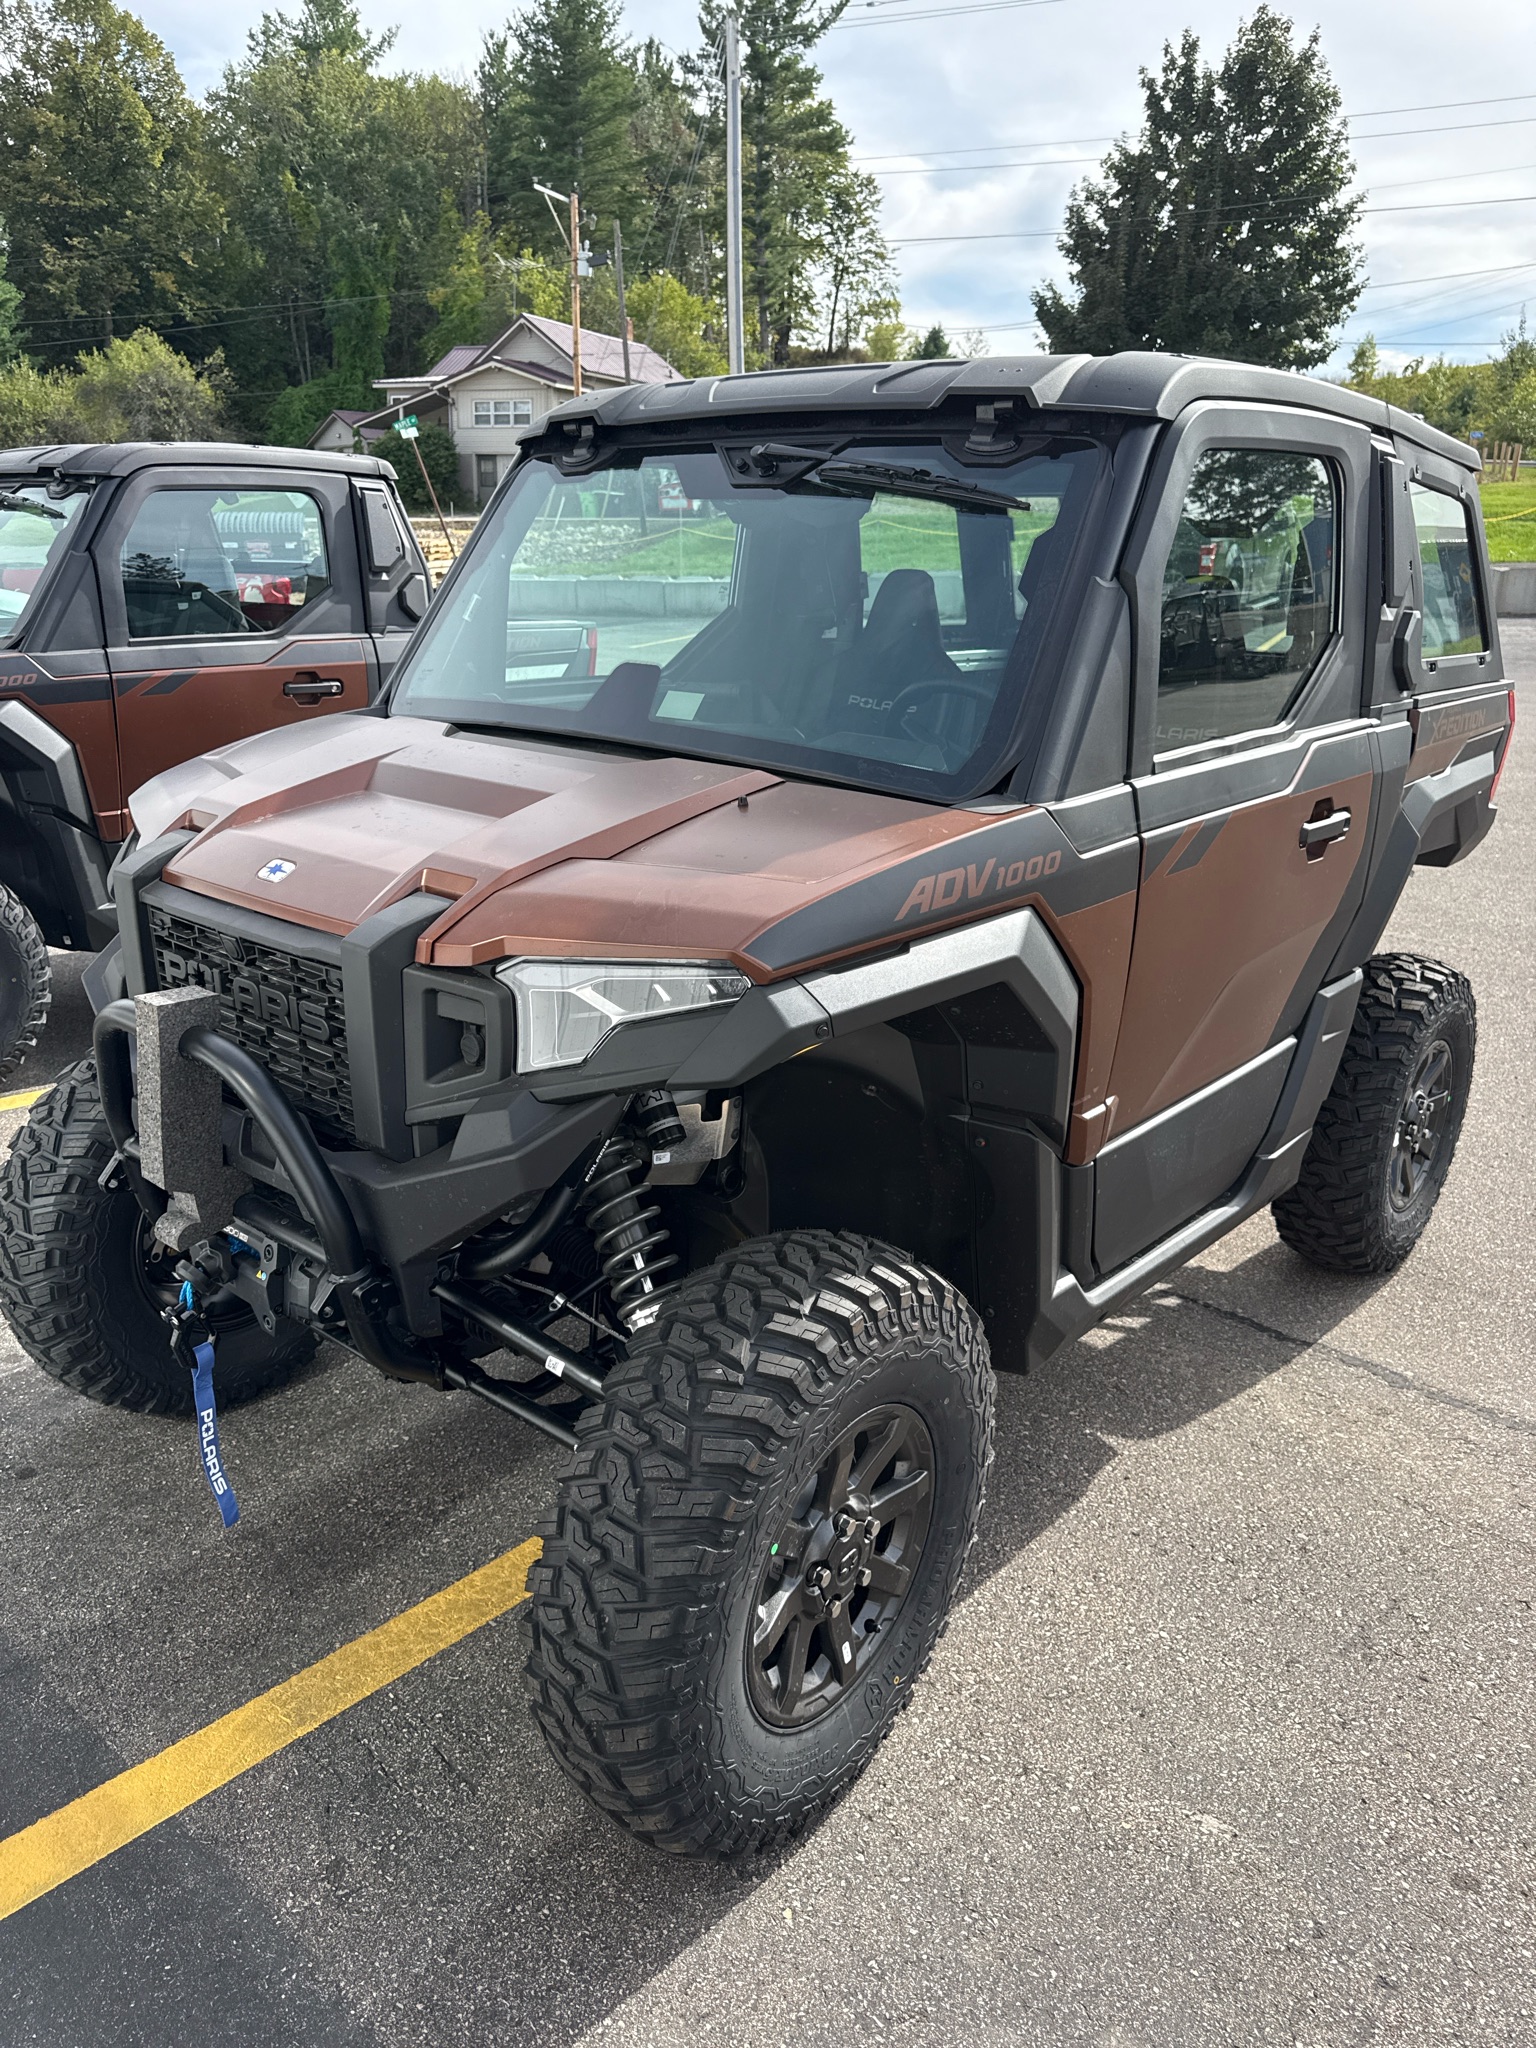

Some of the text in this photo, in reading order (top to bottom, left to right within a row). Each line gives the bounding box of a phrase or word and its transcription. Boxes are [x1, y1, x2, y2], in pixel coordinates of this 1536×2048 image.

[394, 418, 411, 430] MAPLE
[894, 849, 1062, 922] ADV 1000
[163, 949, 331, 1042] POLARIS
[584, 1139, 611, 1182] POLARIS
[200, 1407, 228, 1496] POLARIS
